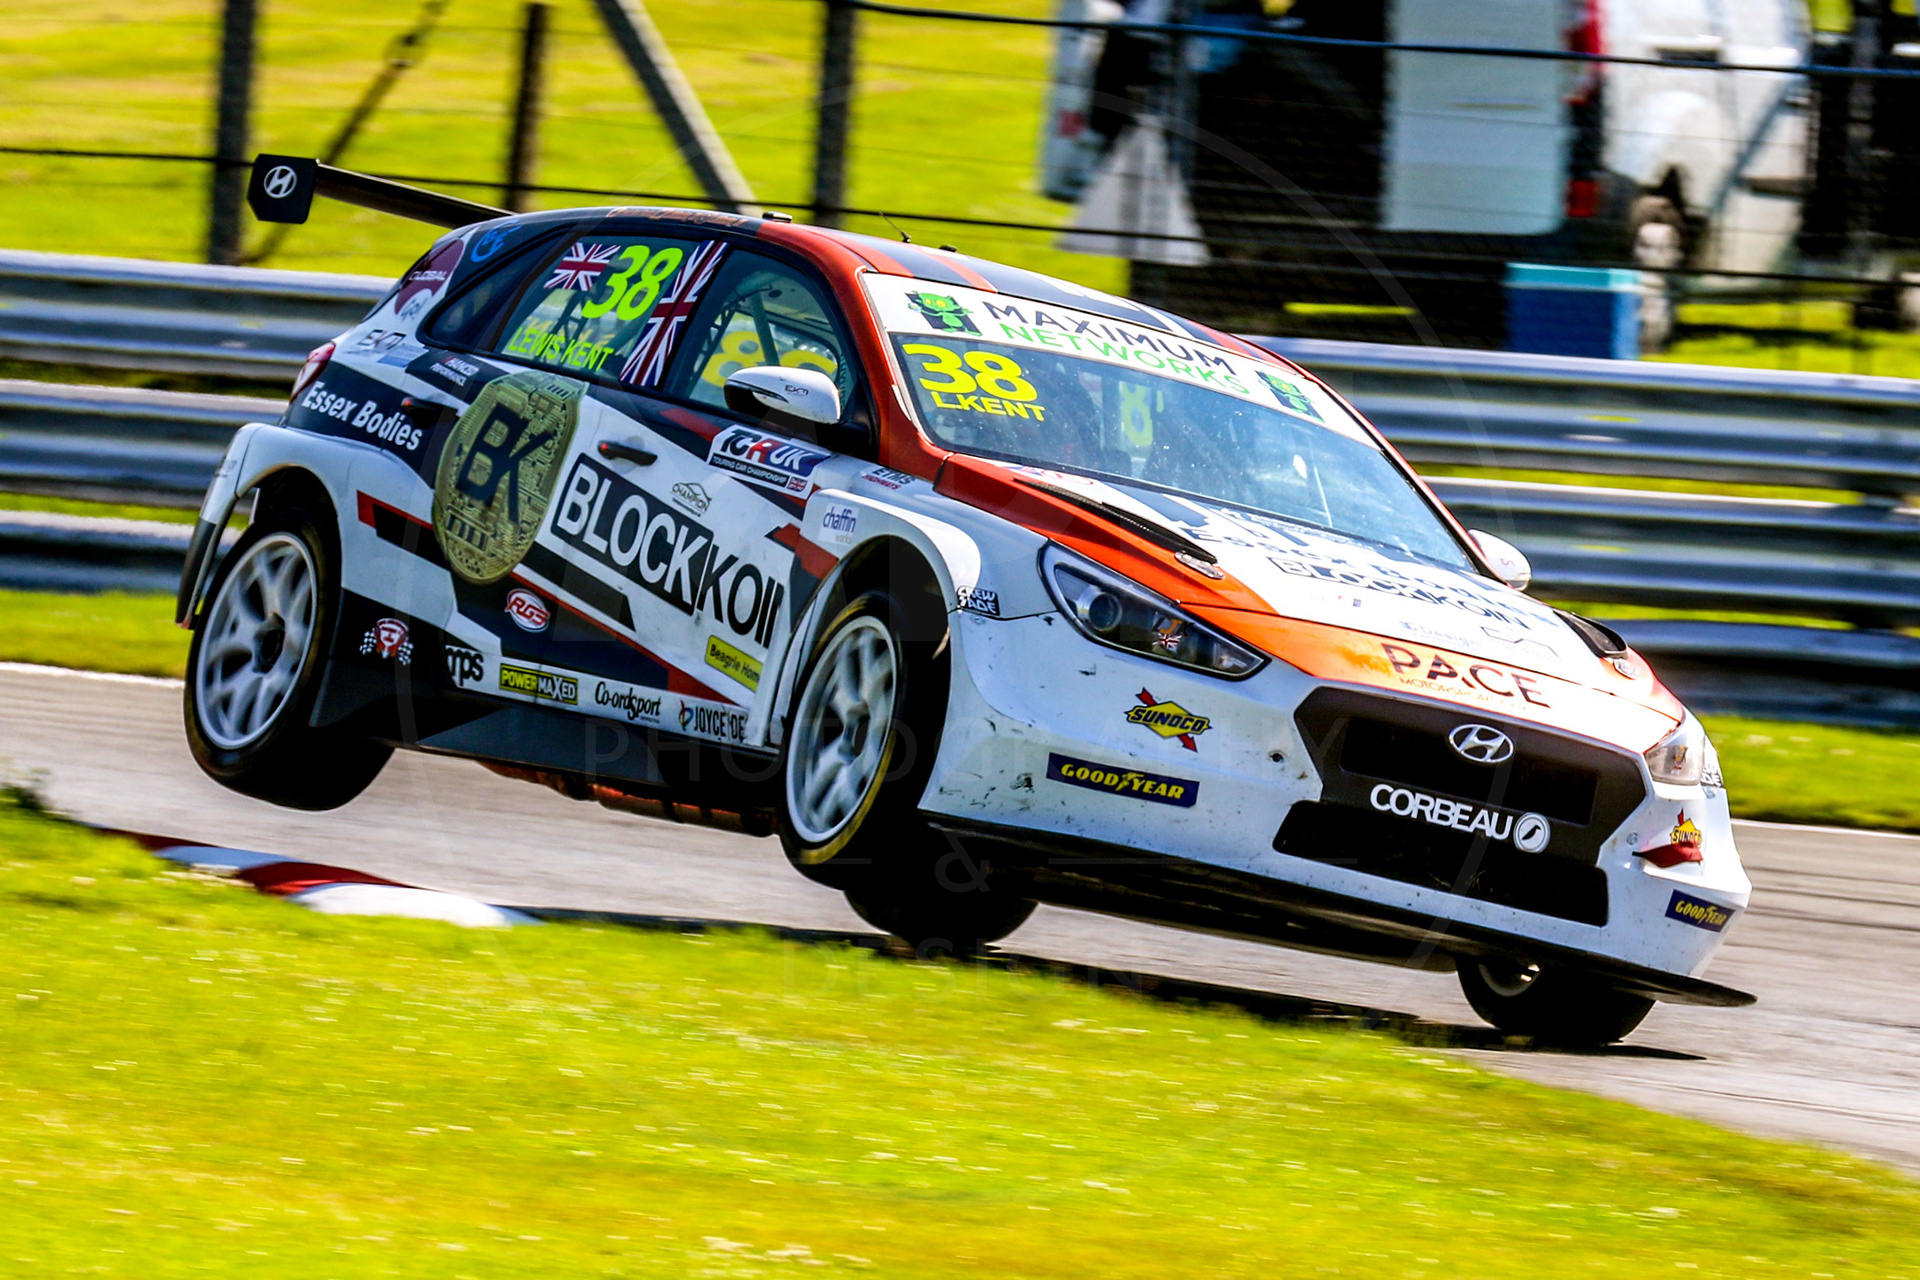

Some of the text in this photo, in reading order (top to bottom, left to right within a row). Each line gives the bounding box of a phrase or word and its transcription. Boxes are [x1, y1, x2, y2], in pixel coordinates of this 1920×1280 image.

[582, 245, 684, 321] 38
[508, 326, 615, 371] LEWIS KENT
[983, 300, 1238, 376] MAXIMUM
[1000, 324, 1250, 395] NETWORKS
[902, 343, 1038, 402] 38
[301, 381, 423, 450] Essex Bodies
[455, 402, 552, 527] BK
[712, 455, 788, 484] TOURING CAR CHAMPIONSHIP
[720, 429, 814, 471] TCR UK
[672, 483, 707, 512] CHAMPION
[823, 506, 856, 533] chaffin
[505, 597, 550, 627] RGS
[710, 644, 741, 672] Beagrie
[1381, 643, 1552, 709] PACE
[694, 706, 726, 738] JOYCE
[1130, 708, 1206, 732] SUNOCO
[1370, 784, 1513, 840] CORBEAU
